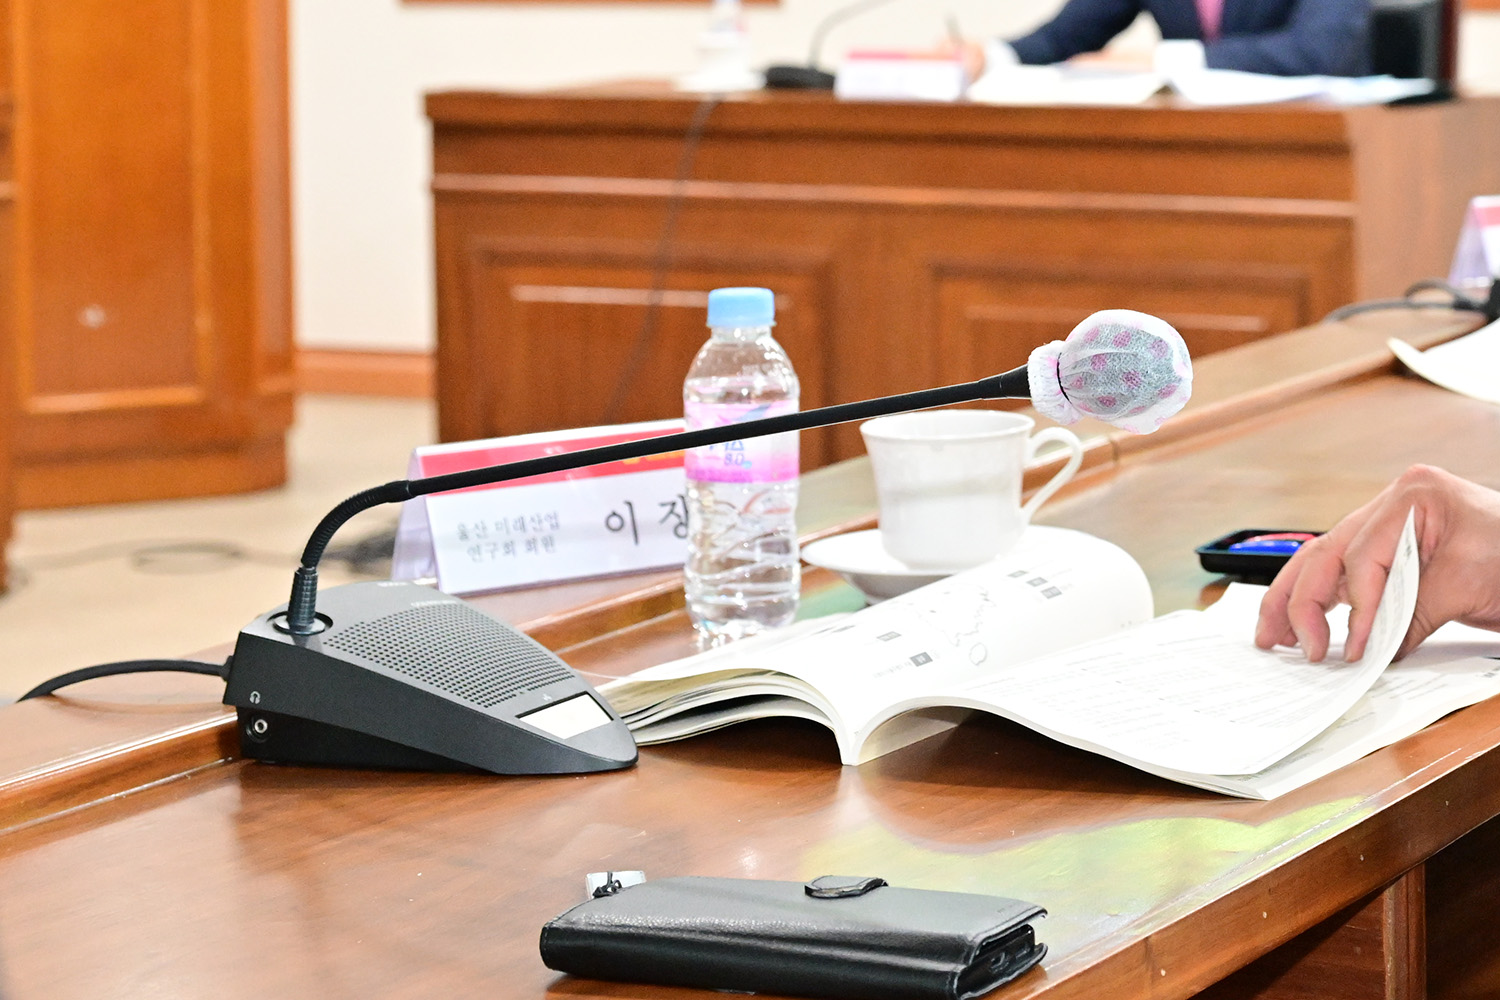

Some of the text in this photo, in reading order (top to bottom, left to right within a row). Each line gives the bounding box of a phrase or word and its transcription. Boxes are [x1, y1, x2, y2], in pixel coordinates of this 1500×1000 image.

[457, 520, 489, 541] 울산
[494, 511, 560, 535] 미래산업
[605, 500, 639, 545] 이
[467, 535, 556, 562] 연구회 회원
